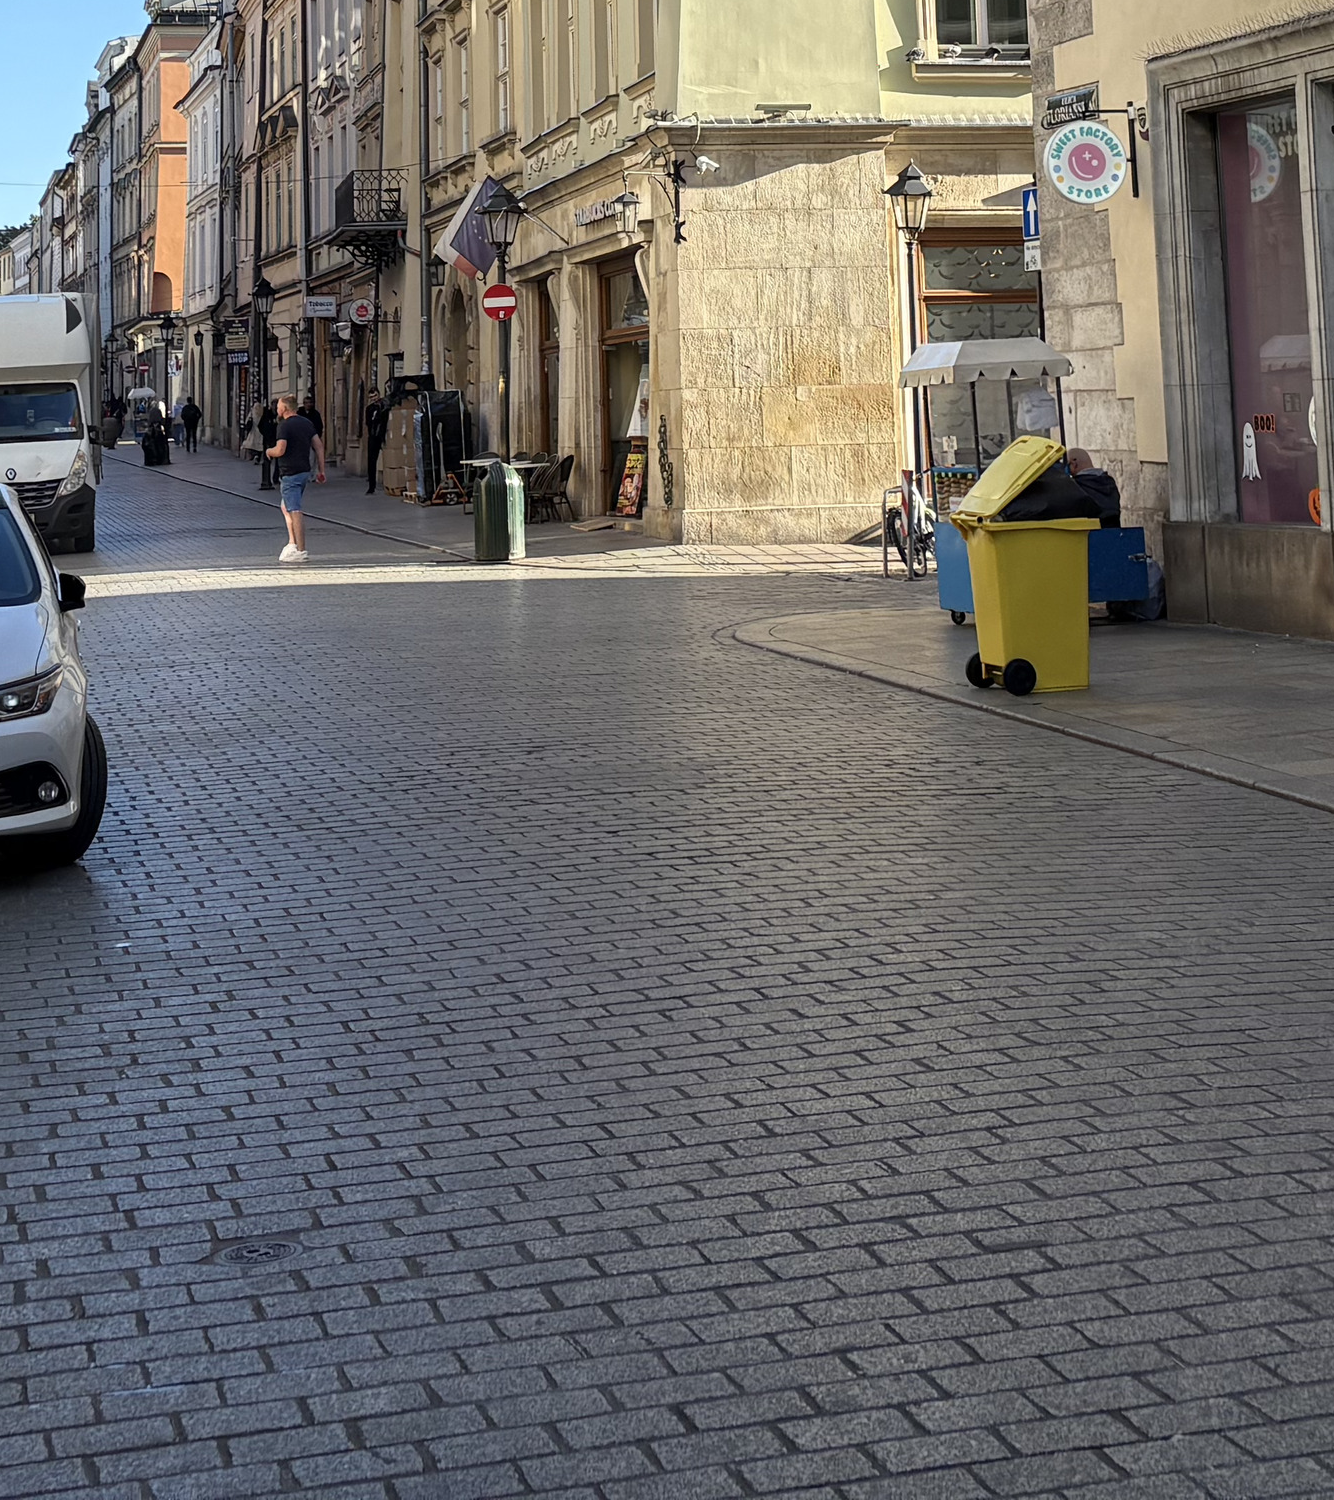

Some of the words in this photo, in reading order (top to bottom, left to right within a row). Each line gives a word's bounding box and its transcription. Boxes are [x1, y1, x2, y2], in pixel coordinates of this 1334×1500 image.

[1051, 129, 1076, 160] SWEET
[1079, 126, 1123, 158] FACTORY
[1066, 184, 1110, 199] STORE
[1254, 414, 1275, 432] BOO!
